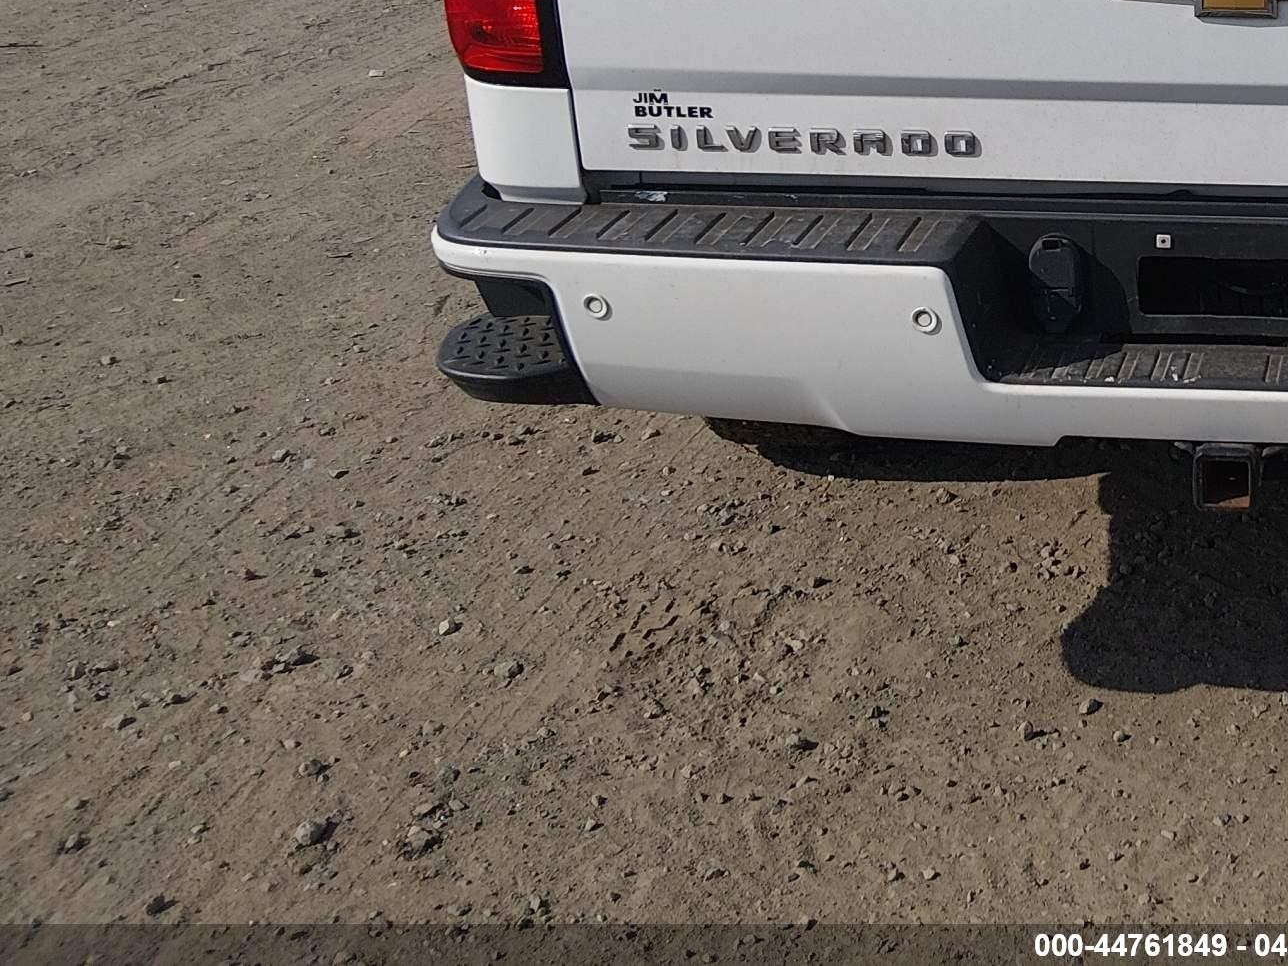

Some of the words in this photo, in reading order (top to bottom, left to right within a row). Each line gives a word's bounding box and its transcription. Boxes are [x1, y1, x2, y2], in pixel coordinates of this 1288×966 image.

[632, 92, 668, 104] JIM
[634, 105, 713, 118] BUTLER
[627, 124, 980, 157] SILVERADO
